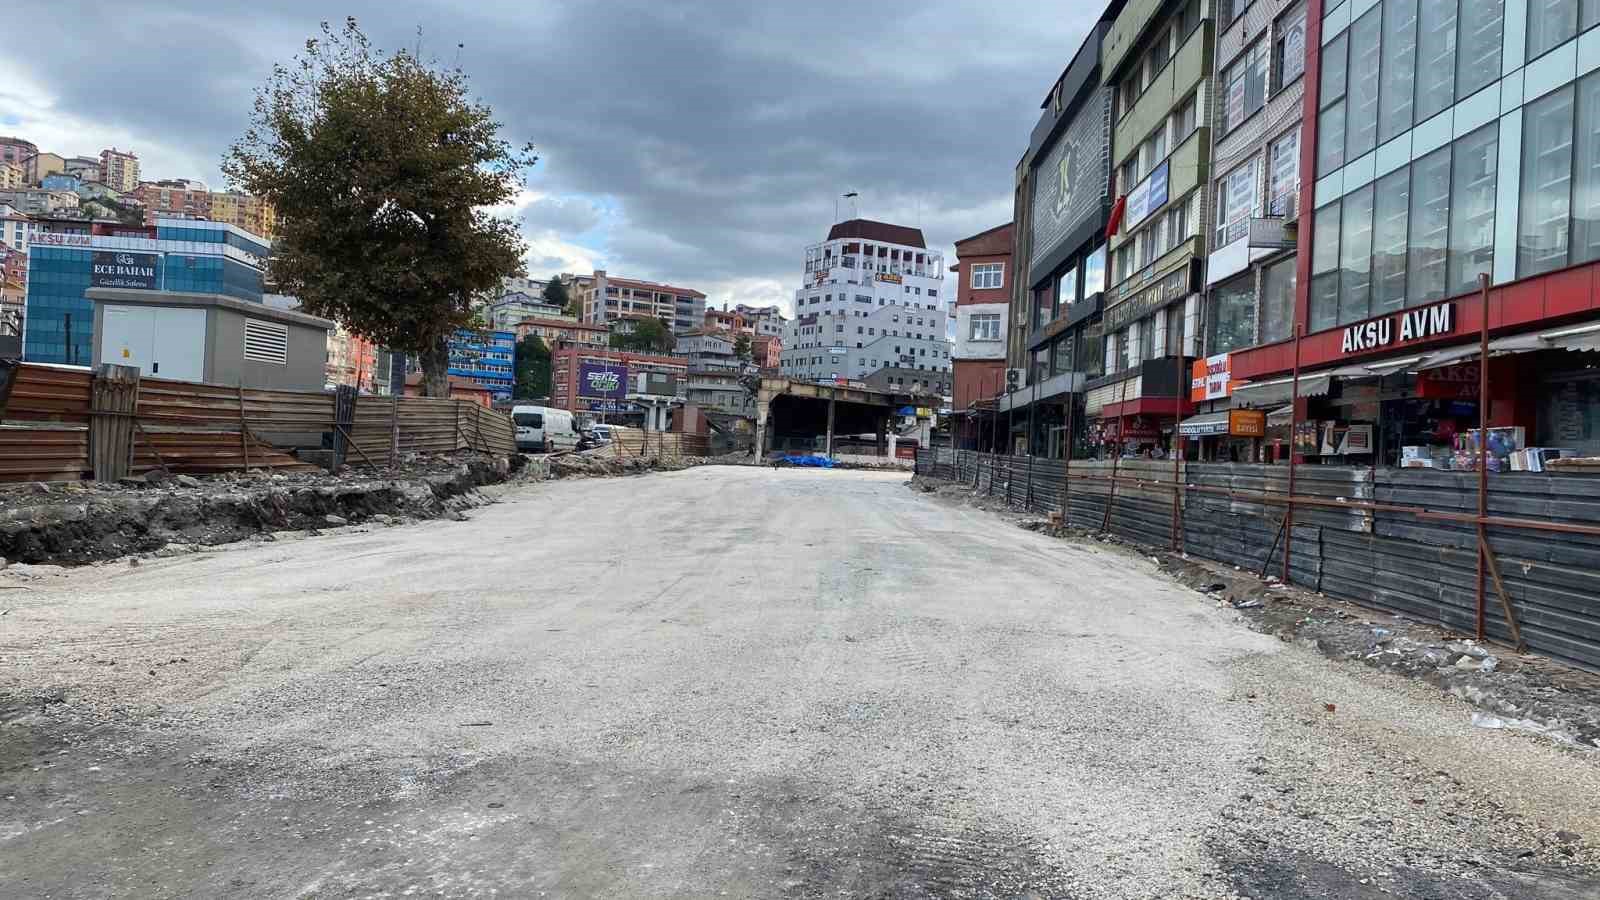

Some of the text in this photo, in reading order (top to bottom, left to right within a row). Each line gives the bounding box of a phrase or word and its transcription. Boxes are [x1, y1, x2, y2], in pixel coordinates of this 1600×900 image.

[29, 232, 91, 246] AKSU AVM
[94, 264, 153, 277] ECE BAHAR
[1341, 303, 1450, 353] AKSU AVM
